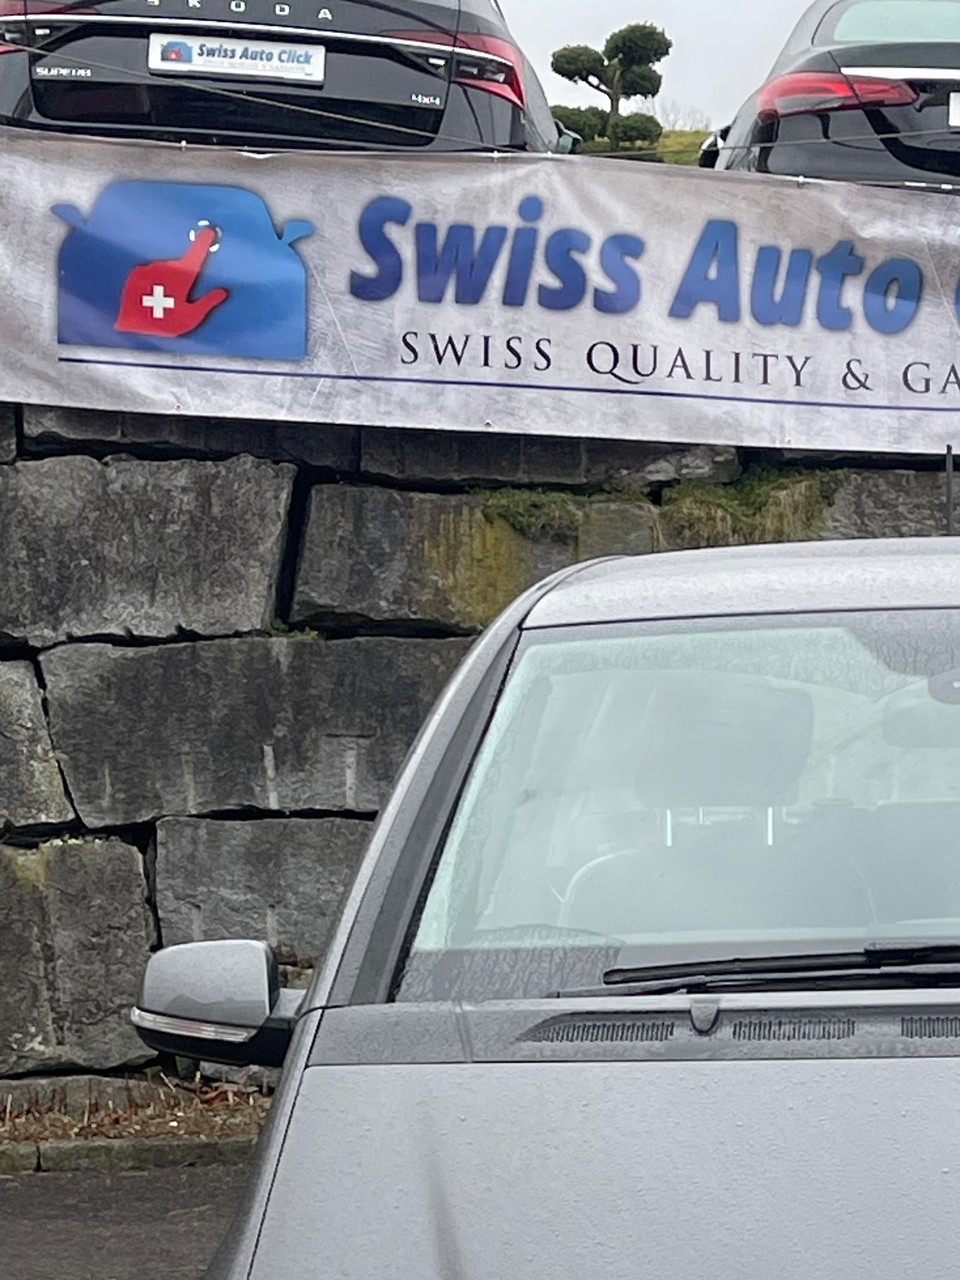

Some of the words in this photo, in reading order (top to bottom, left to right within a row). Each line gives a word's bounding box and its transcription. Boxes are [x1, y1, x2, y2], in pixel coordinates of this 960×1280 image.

[197, 43, 236, 60] Swiss
[239, 46, 273, 63] Auto
[277, 49, 314, 65] Click
[349, 195, 646, 314] Swiss
[667, 218, 924, 336] Auto
[400, 331, 552, 372] SWISS
[585, 340, 814, 388] QUALITY
[841, 357, 874, 392] &
